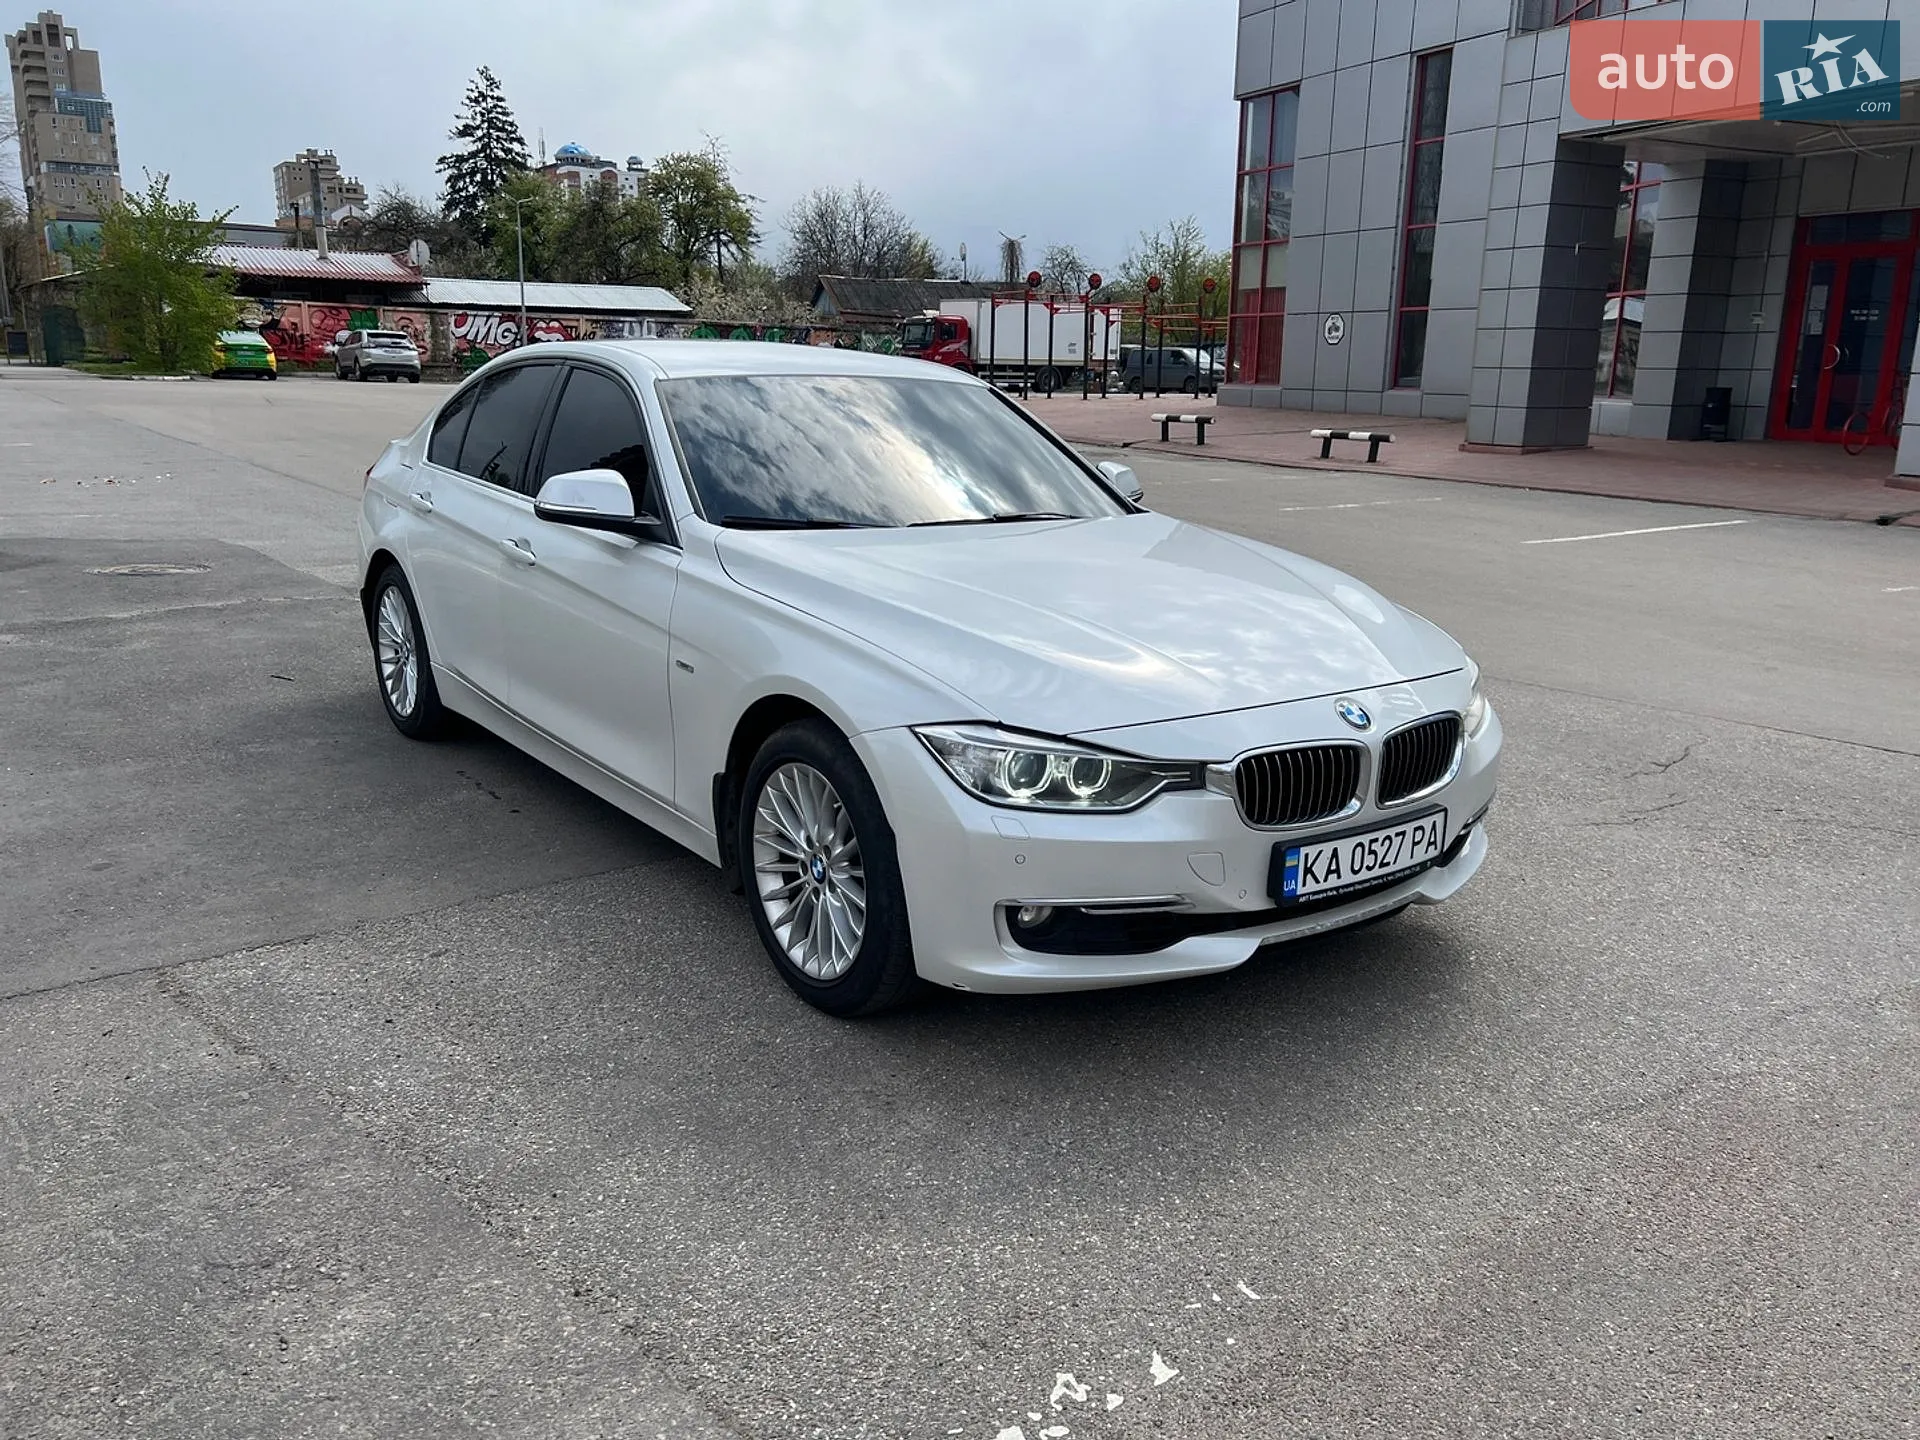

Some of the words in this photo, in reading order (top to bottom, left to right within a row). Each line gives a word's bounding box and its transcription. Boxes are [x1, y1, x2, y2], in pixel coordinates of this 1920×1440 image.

[1302, 847, 1342, 888] KA
[1350, 830, 1407, 876] 0527
[1410, 820, 1438, 859] PA
[1283, 879, 1297, 892] UA
